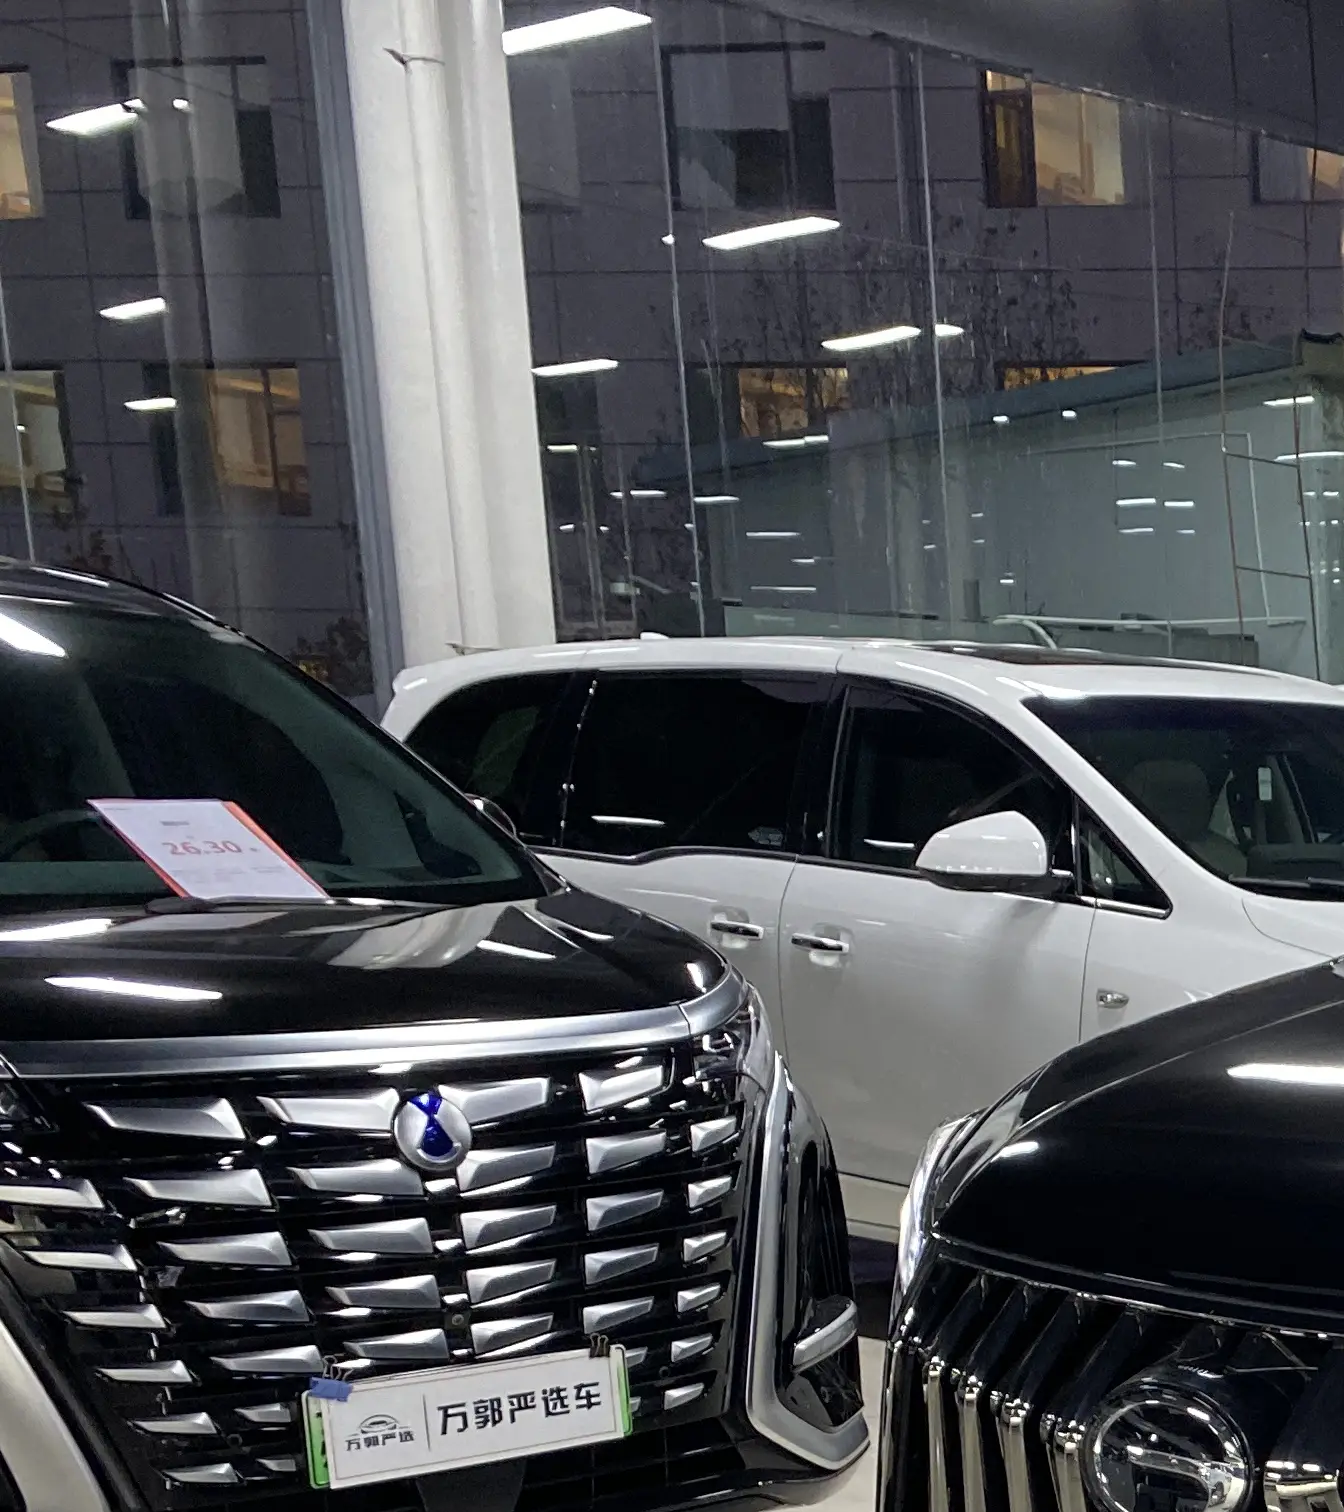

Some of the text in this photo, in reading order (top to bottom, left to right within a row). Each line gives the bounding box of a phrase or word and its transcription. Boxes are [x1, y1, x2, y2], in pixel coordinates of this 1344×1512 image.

[436, 1381, 602, 1437] 万郭严选车
